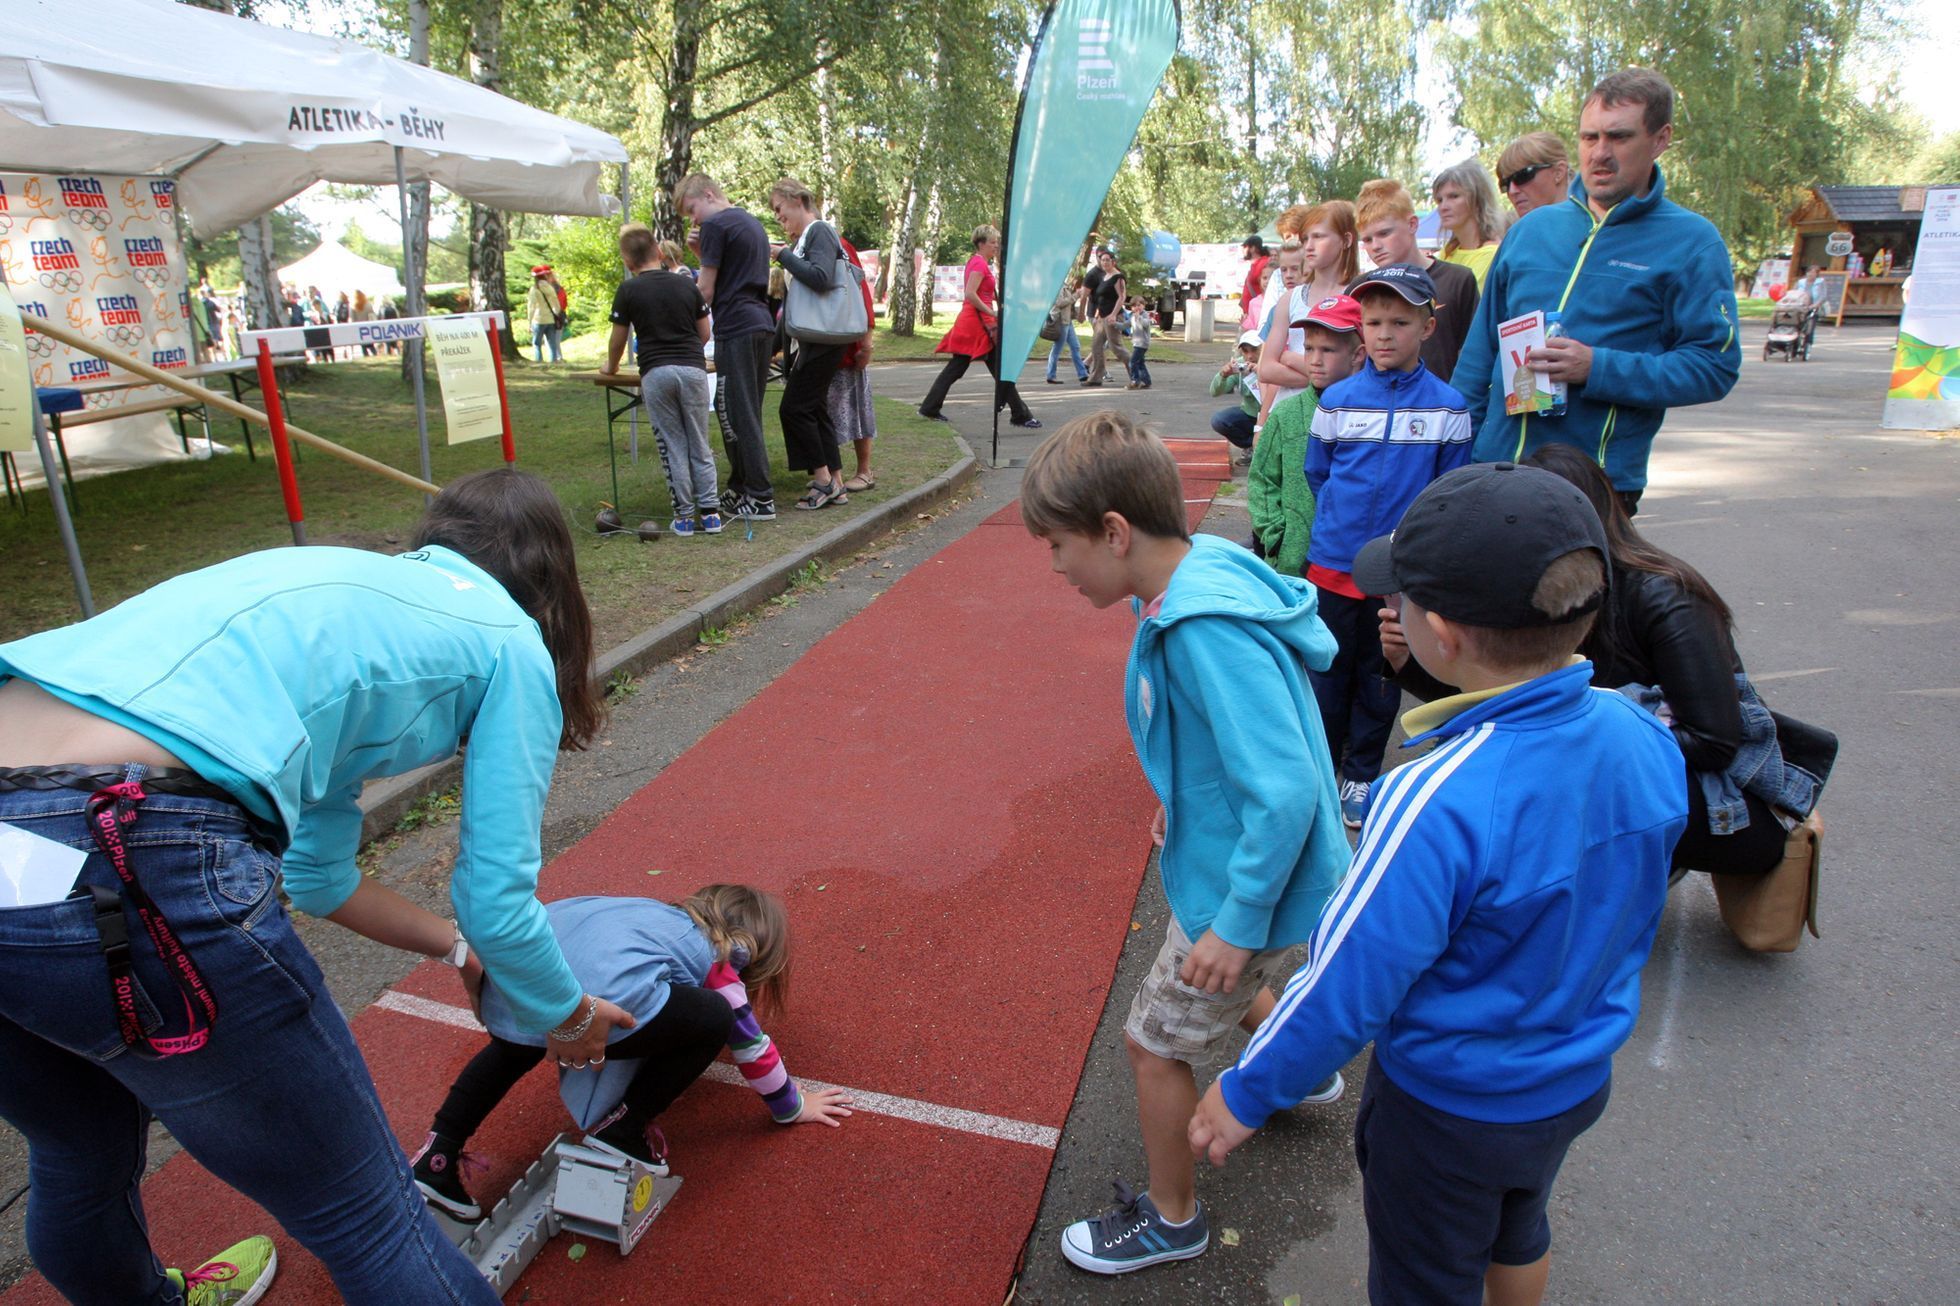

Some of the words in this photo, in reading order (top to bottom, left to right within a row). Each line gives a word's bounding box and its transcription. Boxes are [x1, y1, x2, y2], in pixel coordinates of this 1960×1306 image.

[1077, 74, 1117, 89] Plzeň
[288, 106, 385, 132] ATLETIKA
[400, 106, 445, 142] BĚHY
[57, 176, 103, 194] czech
[62, 192, 108, 209] team
[31, 236, 75, 256] czech
[124, 235, 164, 252] czech
[1831, 242, 1847, 252] 66
[33, 254, 80, 271] team
[127, 251, 168, 267] team
[97, 293, 139, 310] czech
[100, 309, 142, 325] team
[359, 323, 421, 341] POLANIK
[152, 346, 187, 363] czech
[69, 358, 110, 376] czech
[110, 844, 134, 883] Plzeň
[153, 915, 182, 956] kultury
[176, 954, 202, 989] město
